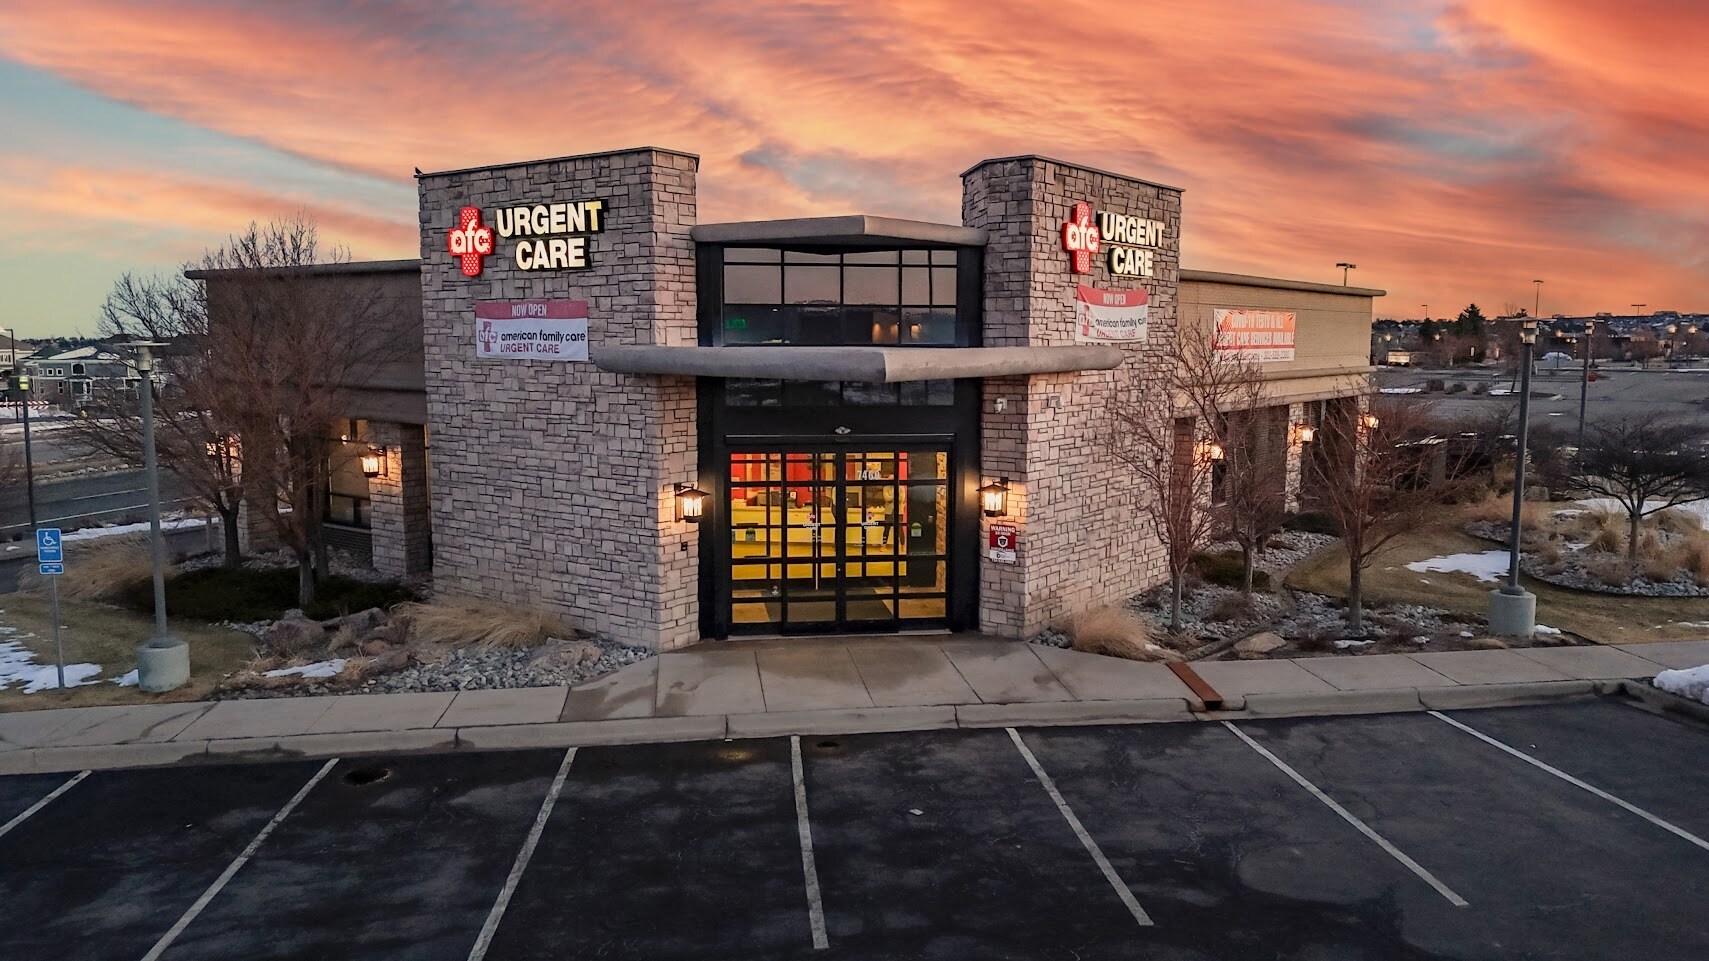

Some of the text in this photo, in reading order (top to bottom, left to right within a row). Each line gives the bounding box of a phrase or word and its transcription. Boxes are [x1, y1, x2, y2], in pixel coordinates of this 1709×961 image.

[496, 201, 602, 237] URGENT
[1066, 216, 1098, 251] afc
[1102, 212, 1165, 247] URGENT
[451, 219, 489, 254] afc
[515, 238, 585, 270] CARE
[1113, 246, 1153, 276] CARE
[512, 304, 547, 316] NOW OPEN
[500, 330, 586, 344] american family care
[500, 343, 560, 353] URGENT CARE
[1120, 328, 1136, 338] CARE
[990, 525, 1015, 533] WARNING
